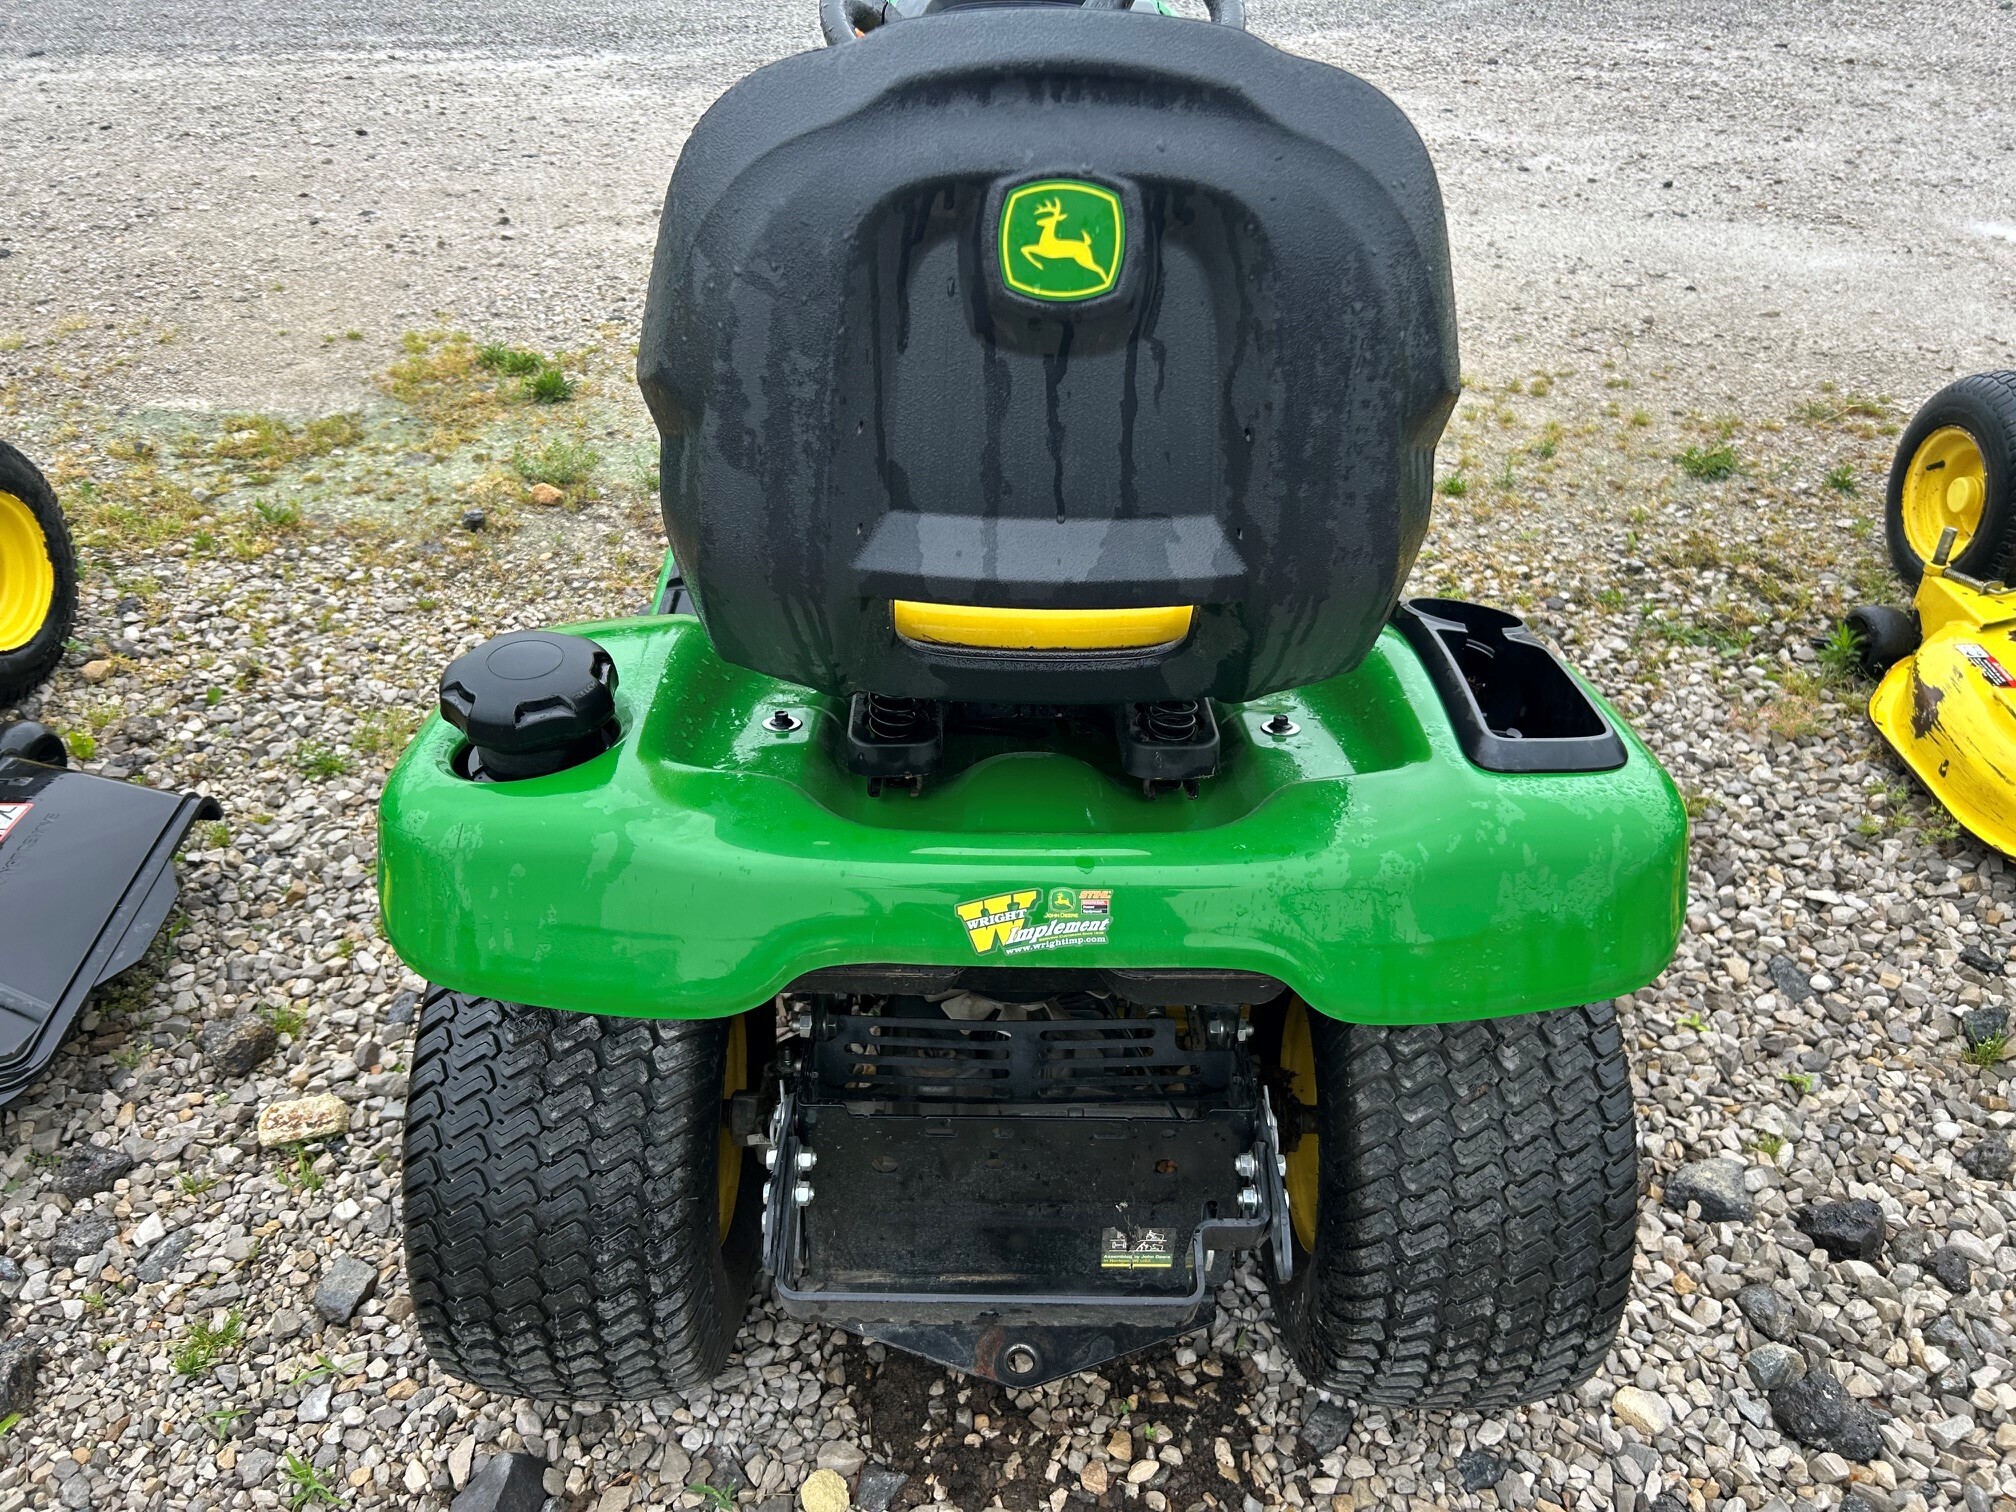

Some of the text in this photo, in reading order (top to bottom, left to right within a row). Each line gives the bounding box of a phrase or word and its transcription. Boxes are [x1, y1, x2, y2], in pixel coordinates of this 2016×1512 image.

[965, 909, 1027, 930] WRIGHT
[1005, 917, 1110, 944] Implement
[1005, 935, 1106, 955] www.wrightimp.com
